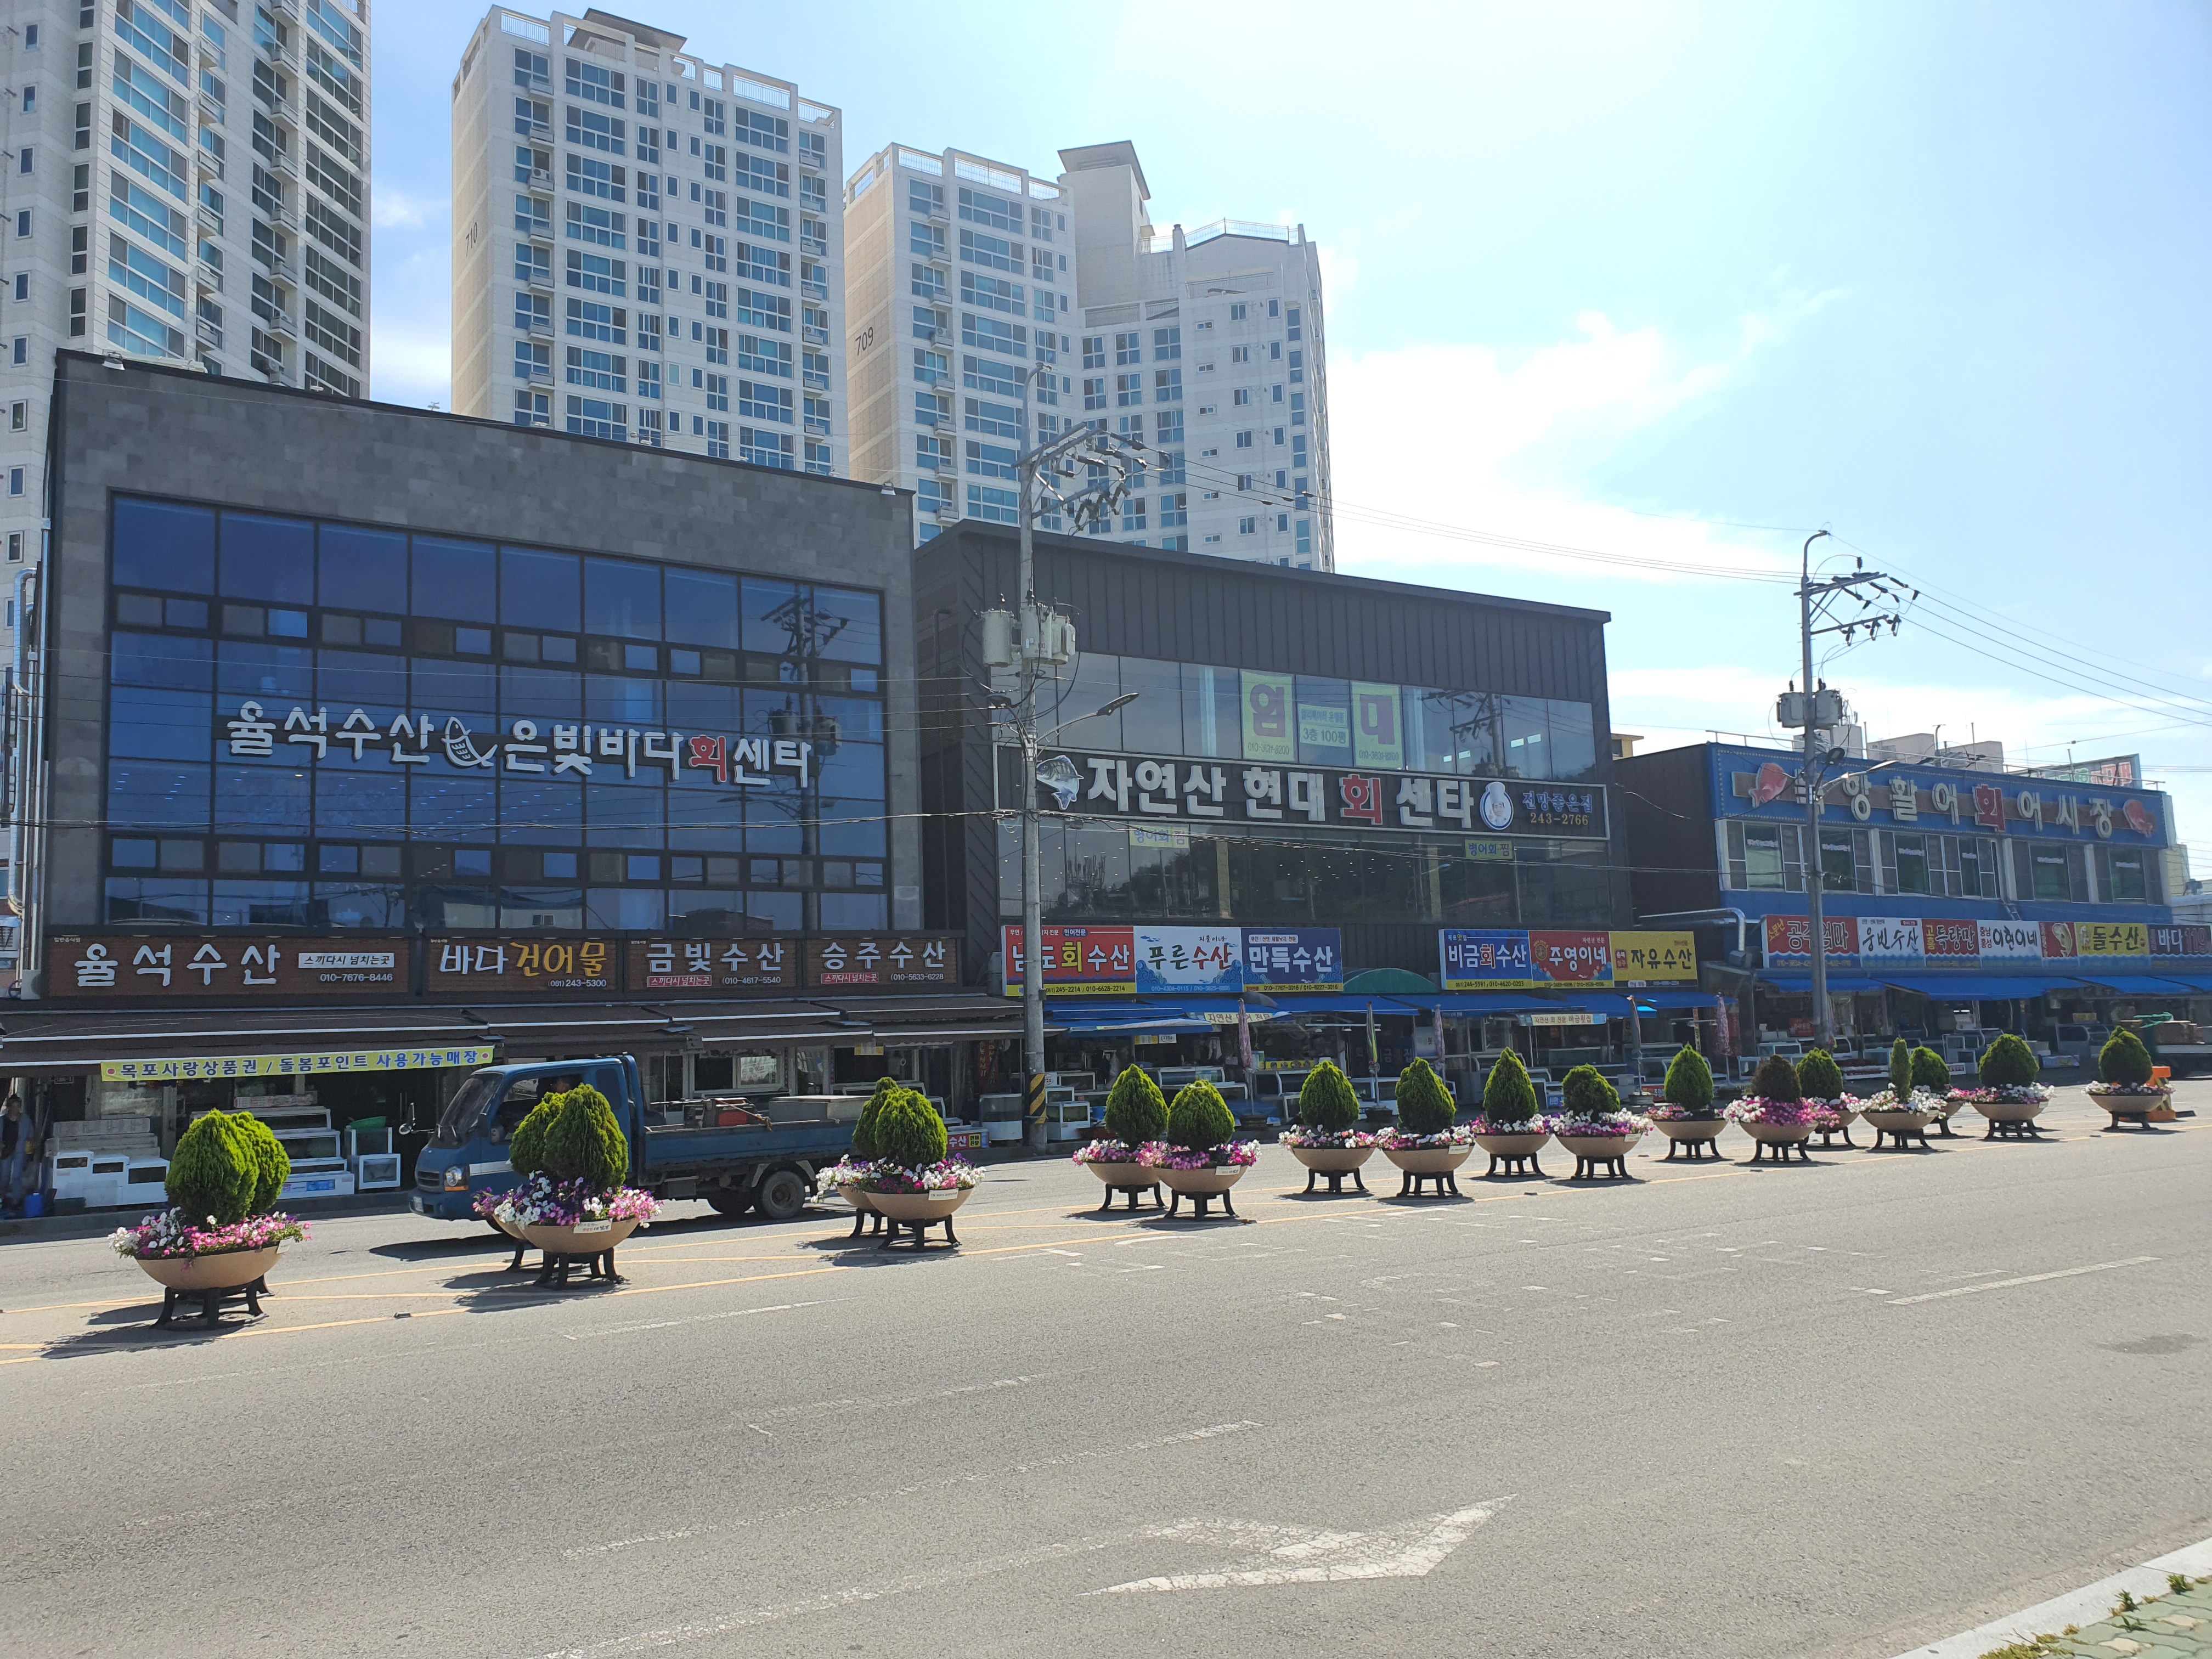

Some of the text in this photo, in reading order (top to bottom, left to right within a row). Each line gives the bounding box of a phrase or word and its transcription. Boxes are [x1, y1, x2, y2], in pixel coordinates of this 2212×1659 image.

[465, 222, 477, 257] 710
[855, 326, 874, 356] 709
[1359, 693, 1395, 745] 대
[227, 700, 812, 788] 율석수산 은빛바다회센타
[1303, 727, 1346, 744] 3층 100평
[1087, 758, 1474, 828] 자연산 현대 회 센타
[1522, 790, 1593, 813] 전망좋은집
[1530, 812, 1588, 825] 243-2766
[1768, 918, 1786, 942] 소문난
[1926, 924, 1936, 950] 고흥
[1993, 925, 2038, 951] 이현이네
[74, 943, 281, 987] 율석수산
[304, 955, 346, 966] 스끼다시
[646, 943, 785, 973] 금빛수산
[820, 941, 946, 970] 승주수산
[1148, 944, 1233, 970] 푸른수산
[1249, 946, 1333, 973] 만득수산
[1448, 943, 1527, 969] 비금회수산
[1549, 946, 1607, 972] 주영이네
[1630, 948, 1692, 969] 자유수산
[320, 973, 393, 982] 010-7676-8446
[651, 977, 680, 986] 스끼다시
[825, 974, 851, 983] 스끼다시
[1086, 984, 1125, 992] 010-6628-2214
[1207, 1013, 1233, 1023] 자연산
[120, 1059, 257, 1079] 목포사랑상품권
[279, 1054, 368, 1073] 돌봄포인트
[376, 1050, 478, 1068] 사용가능매장
[949, 1135, 967, 1148] 수산
